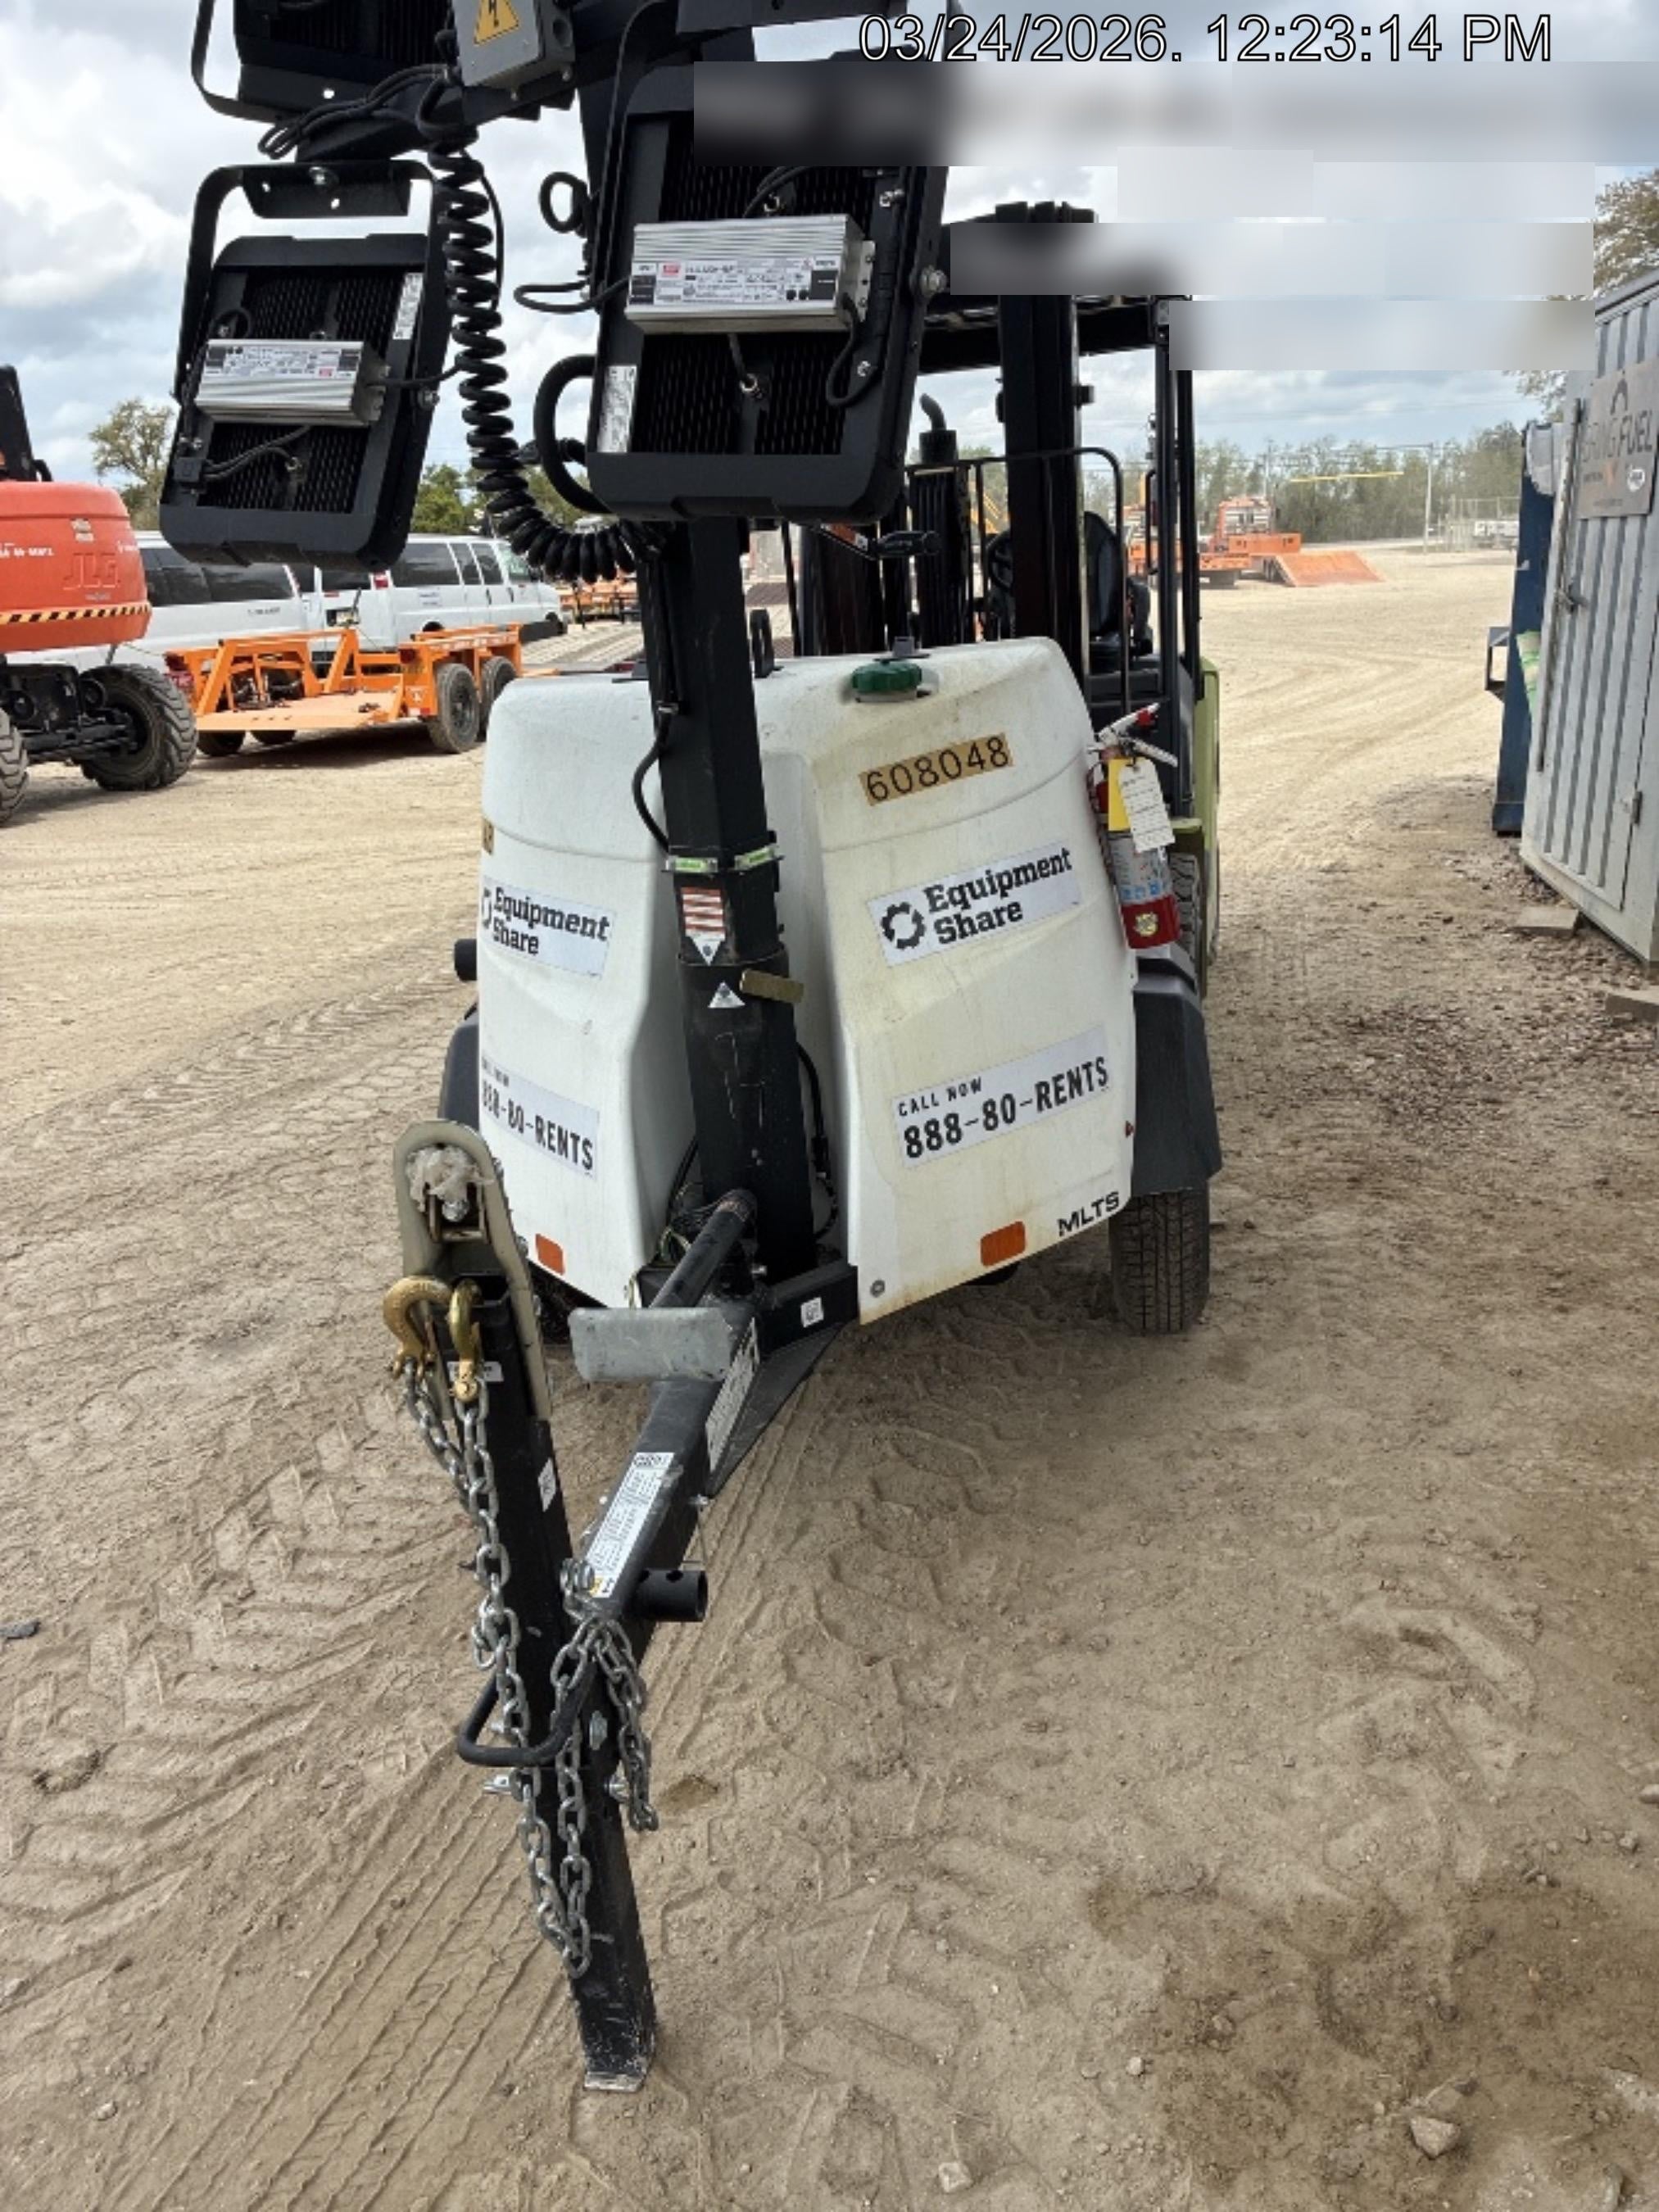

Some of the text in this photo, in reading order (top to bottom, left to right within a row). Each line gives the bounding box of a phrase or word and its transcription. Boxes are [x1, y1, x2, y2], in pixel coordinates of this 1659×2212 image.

[62, 552, 122, 591] JLG
[867, 737, 1009, 801] 608048
[923, 847, 1072, 913] Equipment
[493, 886, 610, 941] Equipment
[493, 916, 539, 956] Share
[934, 901, 1023, 944] Share
[898, 1076, 981, 1117] CALL NOW
[904, 1055, 1108, 1158] 888-80-RENTS
[1057, 1190, 1119, 1236] MLTS
